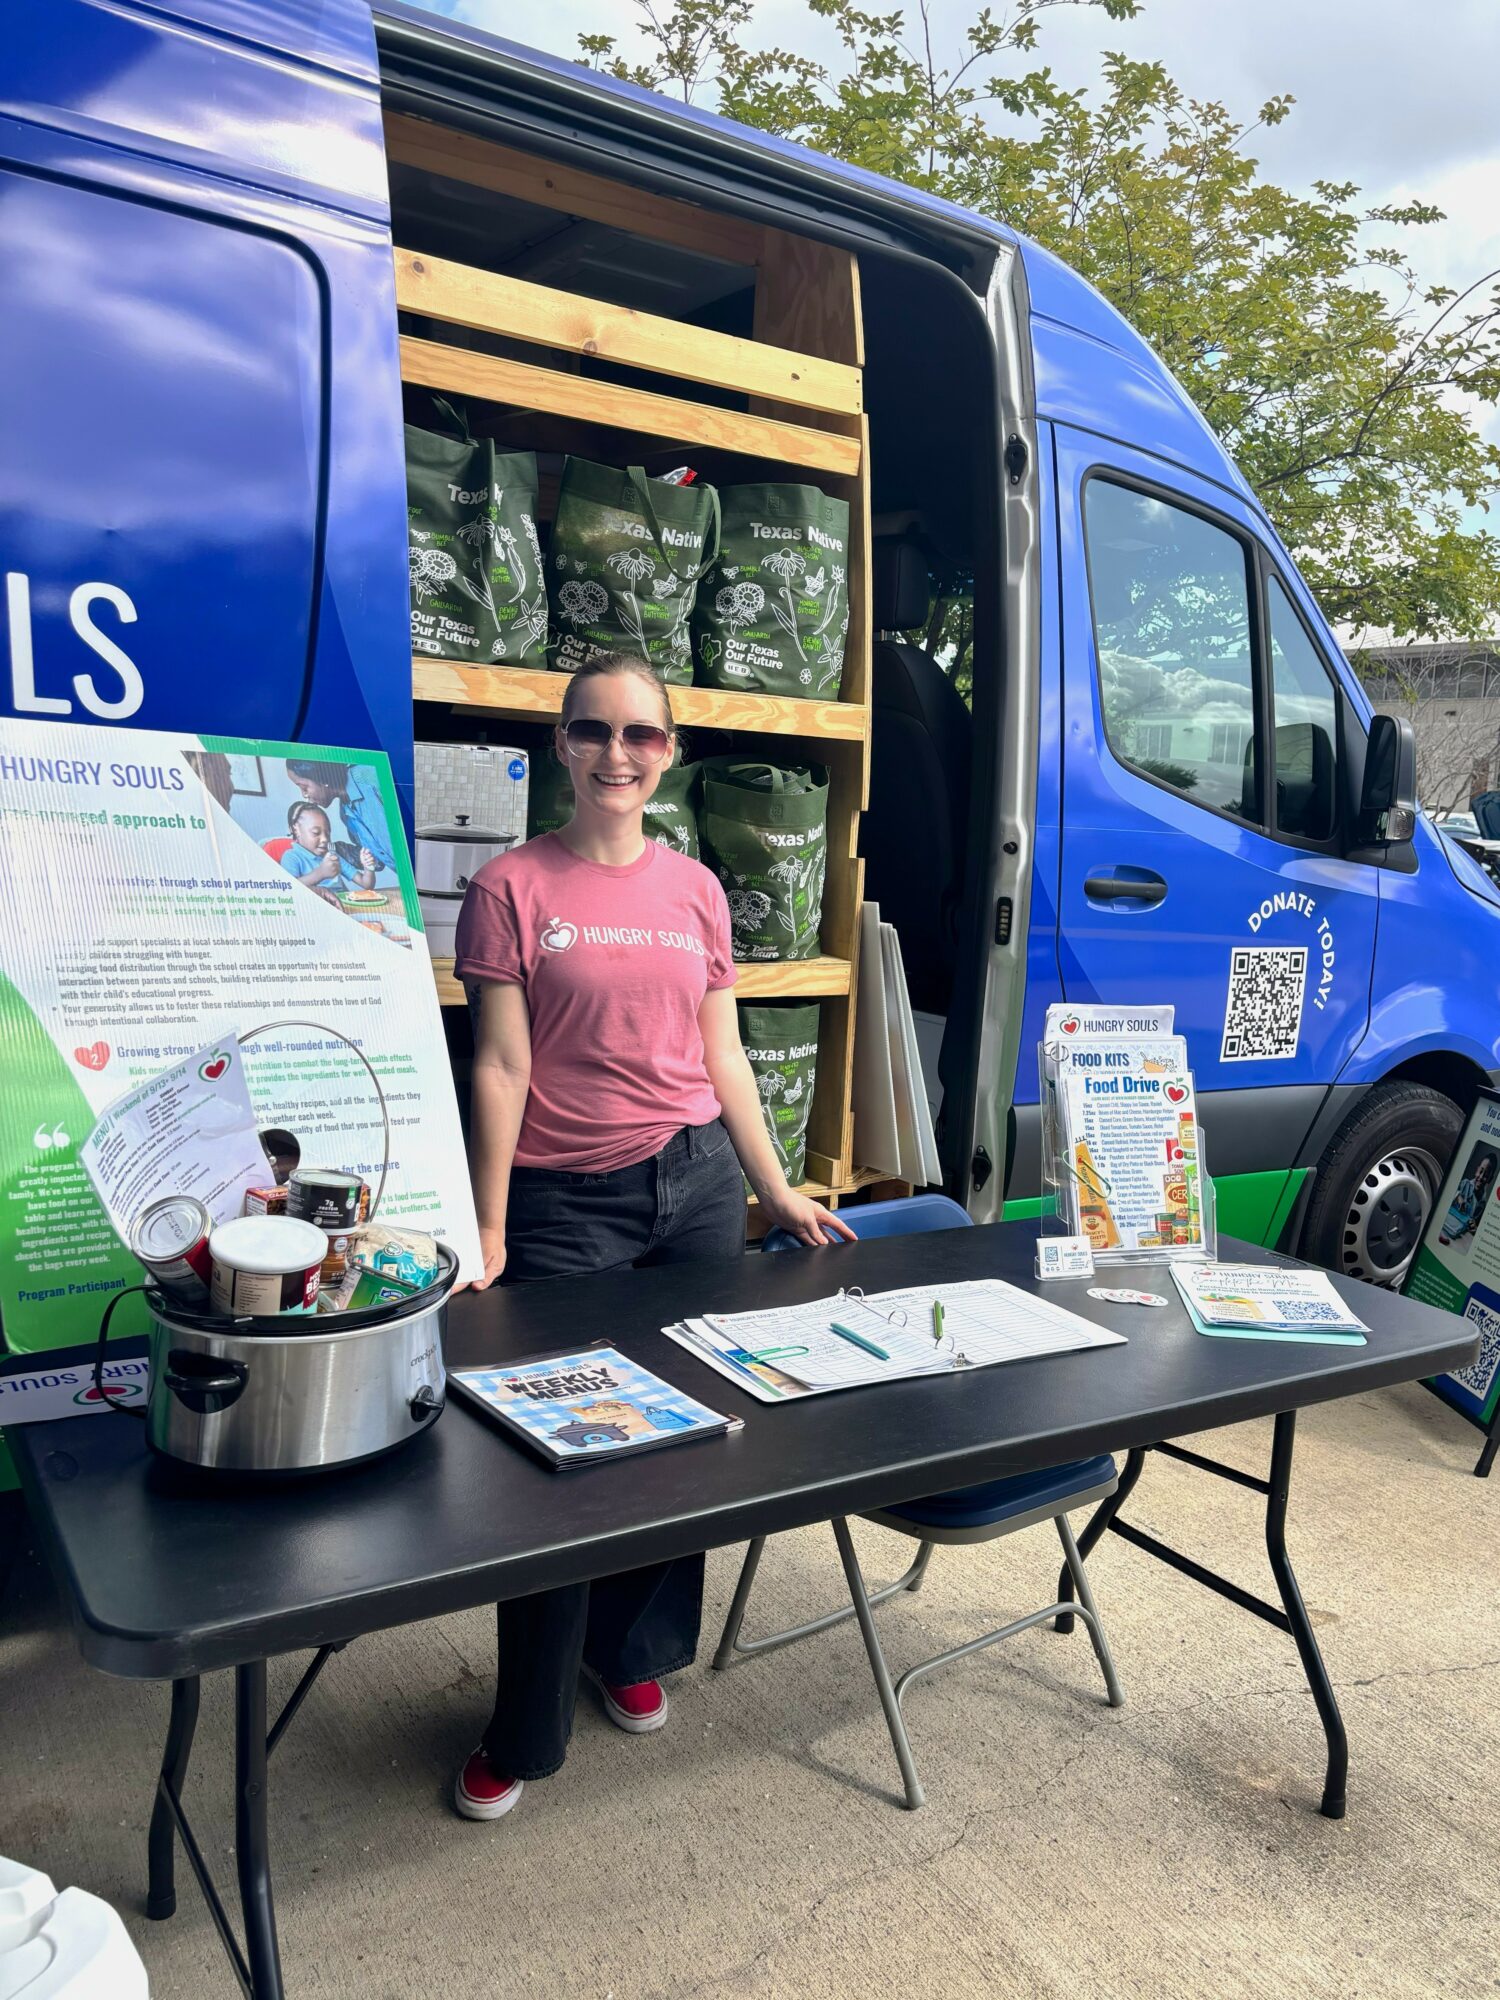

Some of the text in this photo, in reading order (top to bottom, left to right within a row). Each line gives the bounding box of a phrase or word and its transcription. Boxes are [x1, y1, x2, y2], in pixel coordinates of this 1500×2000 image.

[448, 484, 488, 505] Texas
[750, 522, 843, 552] Texas Native
[411, 610, 475, 634] Our Texas
[411, 622, 480, 648] Our Future
[561, 644, 583, 659] Our
[565, 634, 615, 656] Our Tex
[726, 639, 779, 658] Our Texas
[725, 650, 783, 670] Our Future
[0, 755, 185, 791] HUNGRY SOULS
[113, 813, 186, 830] approach
[191, 815, 206, 830] to
[760, 832, 805, 846] Texas
[160, 877, 199, 890] through
[201, 877, 232, 889] school
[234, 879, 293, 891] partnerships
[107, 937, 211, 948] support specialists local
[583, 926, 705, 956] HUNGRY SOULS
[89, 951, 122, 959] children
[124, 950, 165, 960] struggling
[166, 950, 182, 959] with
[184, 950, 212, 959] hunger.
[1248, 891, 1334, 1010] DONATE TODAY!
[100, 964, 117, 972] food
[120, 963, 165, 972] distribution
[168, 963, 197, 972] through
[199, 963, 212, 971] the
[214, 962, 237, 970] school
[278, 962, 318, 971] opportunity
[58, 974, 344, 986] interaction between parents and schools, relationships ensuring
[60, 989, 214, 1000] with their child's educational progress.
[128, 998, 343, 1012] allows to these relationships and demonstrate the
[101, 1015, 199, 1026] intentional collaboration.
[1084, 1020, 1158, 1032] HUNGRY SOULS
[117, 1039, 323, 1058] Growing strong well-rounded
[789, 1042, 817, 1060] Native
[1072, 1053, 1130, 1067] FOOD KITS
[1085, 1076, 1160, 1094] Food Drive
[92, 1120, 109, 1149] MENU
[113, 1095, 142, 1121] Weekend
[142, 1090, 149, 1100] of
[170, 1067, 187, 1082] 9/14
[273, 1092, 421, 1111] healthy recipes, they
[266, 1115, 296, 1125] together
[298, 1112, 314, 1121] each
[316, 1111, 336, 1120] week.
[1486, 1105, 1496, 1119] You
[341, 1122, 355, 1130] that
[40, 1163, 74, 1174] program
[357, 1163, 372, 1174] the
[19, 1173, 86, 1188] greatly impacted
[8, 1192, 36, 1200] family.
[48, 1198, 66, 1208] food
[325, 1199, 334, 1207] 7g
[24, 1211, 85, 1223] table and learn
[16, 1220, 99, 1236] healthy recipes, with
[22, 1233, 84, 1249] ingredients and
[14, 1242, 111, 1261] sheets that provided
[28, 1258, 87, 1272] the bags every
[18, 1278, 127, 1302] Program Participant
[524, 1362, 592, 1382] HUNGRY SOULS
[504, 1367, 610, 1393] WEEKLY
[523, 1378, 620, 1401] MENUS
